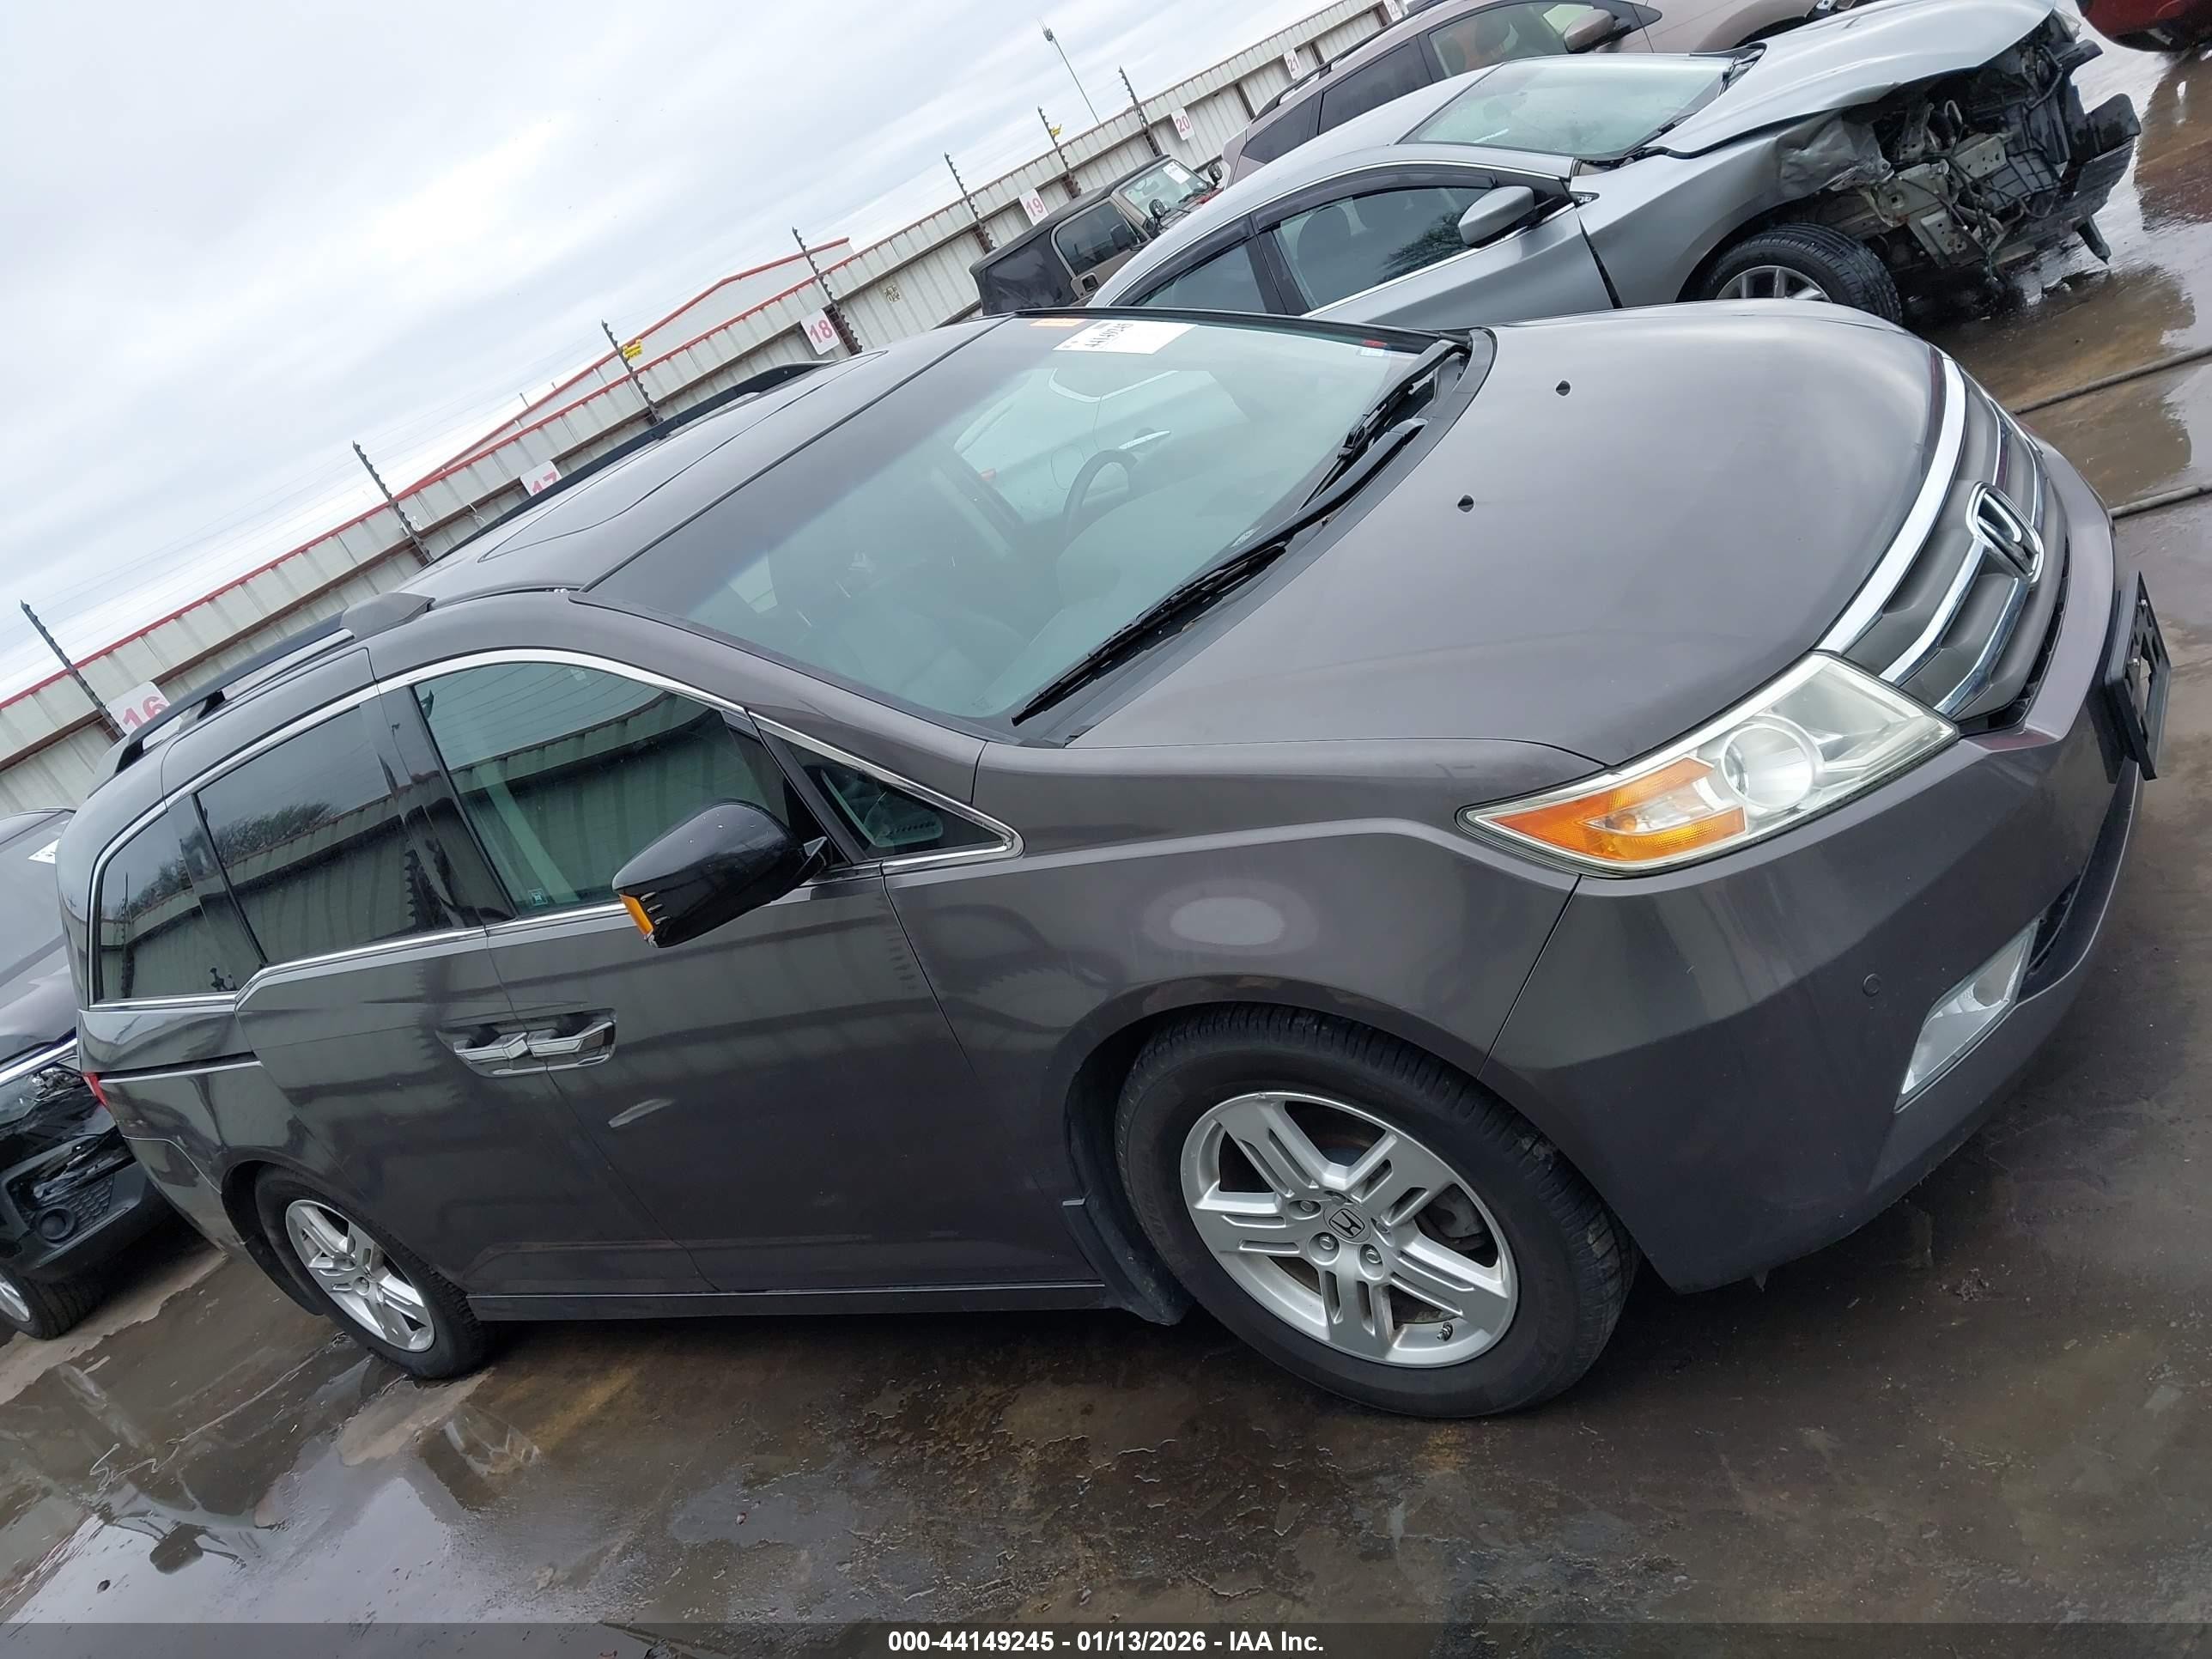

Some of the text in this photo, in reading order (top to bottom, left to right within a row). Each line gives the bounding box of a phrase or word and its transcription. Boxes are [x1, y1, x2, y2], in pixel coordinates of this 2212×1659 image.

[1288, 56, 1300, 72] 21
[1176, 115, 1190, 132] 20
[1026, 198, 1044, 216] 19
[810, 319, 833, 343] 18
[122, 696, 168, 728] 16
